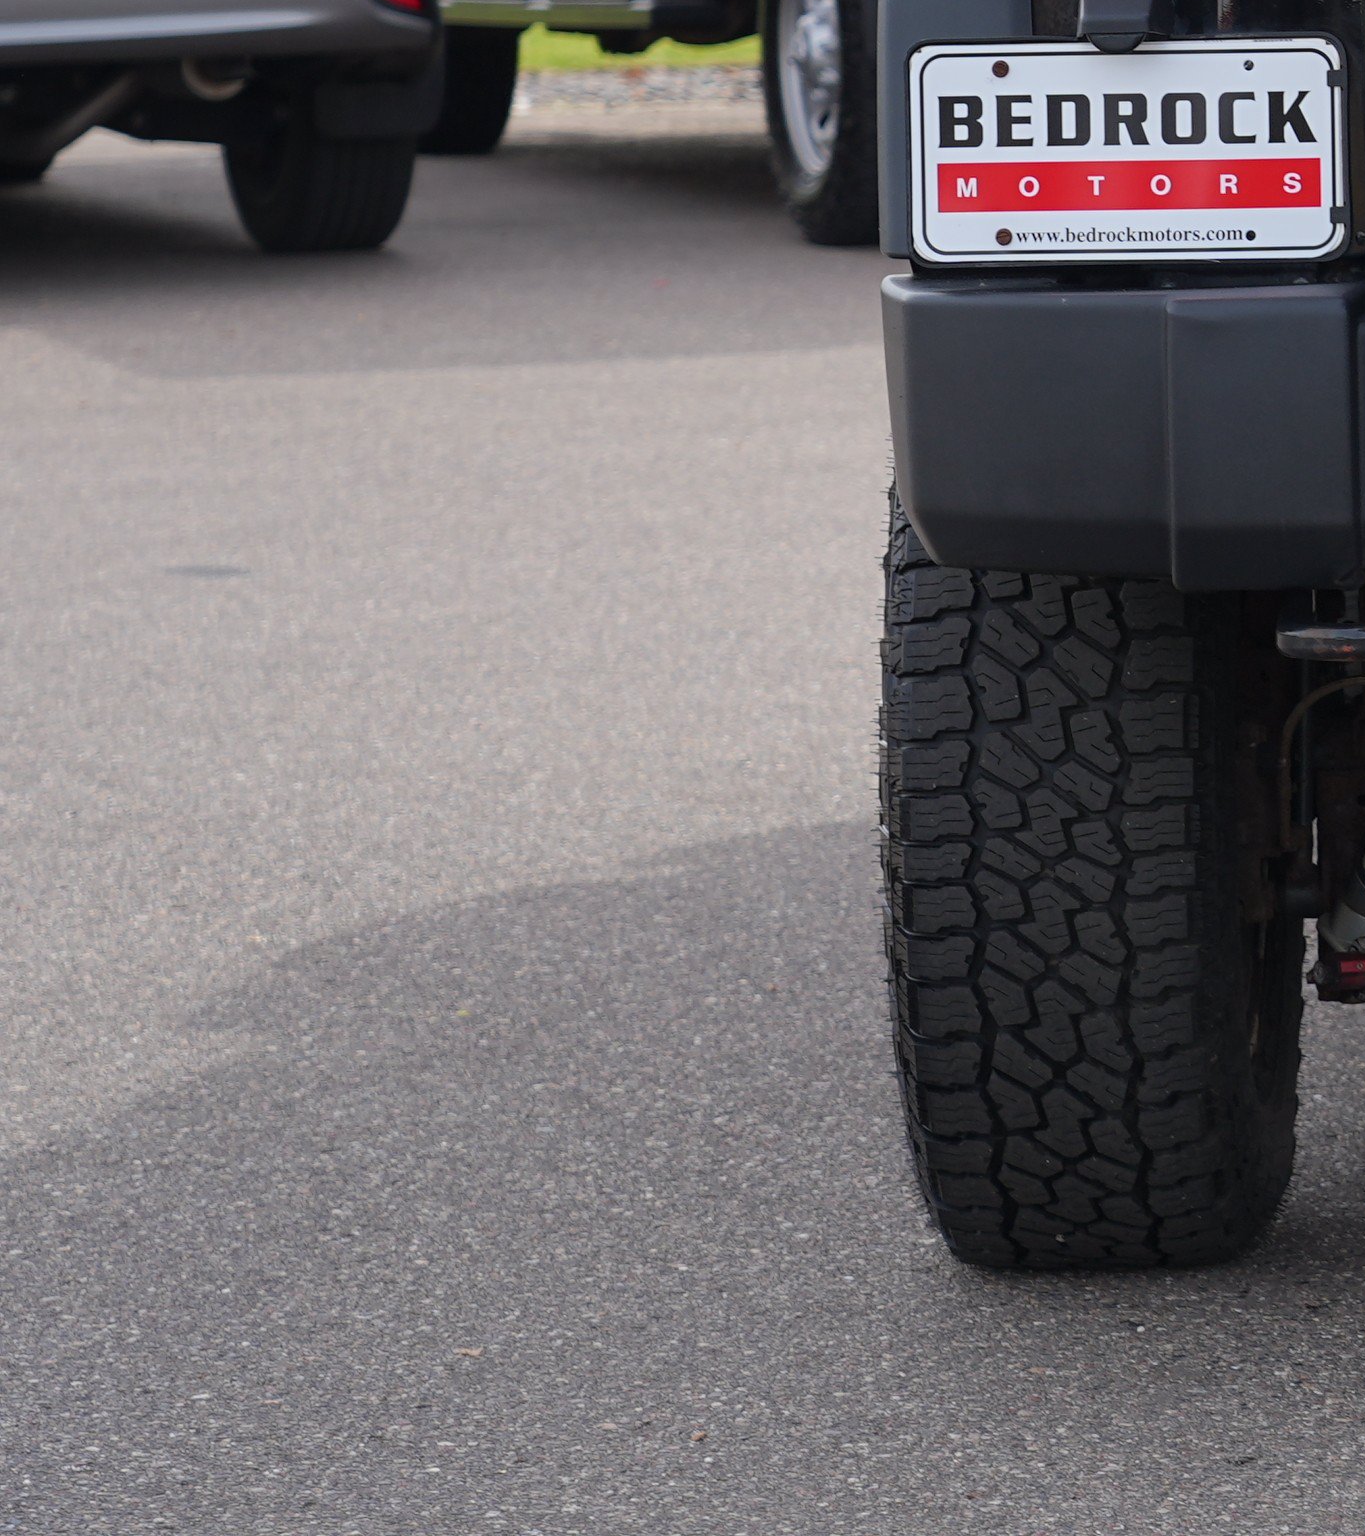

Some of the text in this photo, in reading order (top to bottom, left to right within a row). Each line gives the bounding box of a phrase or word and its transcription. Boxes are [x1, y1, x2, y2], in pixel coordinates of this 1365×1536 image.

[938, 91, 1317, 147] BEDROCK
[956, 173, 1302, 198] MOTORS
[1016, 227, 1244, 244] www.bedrockmotors.com
